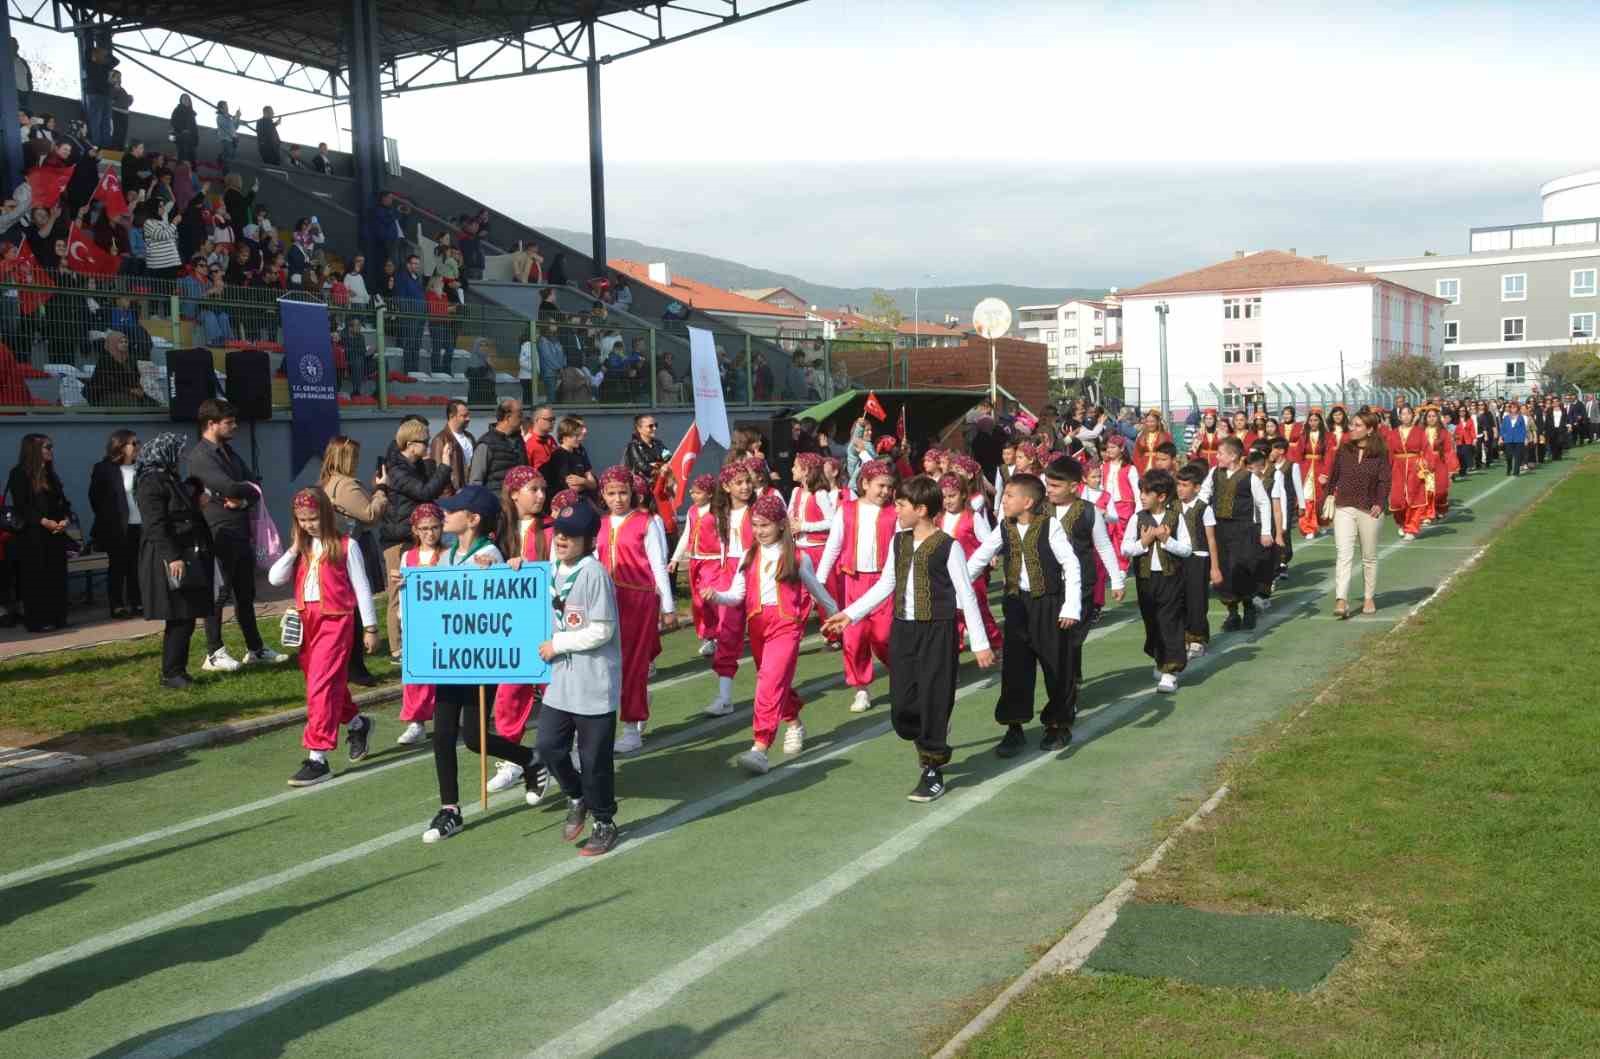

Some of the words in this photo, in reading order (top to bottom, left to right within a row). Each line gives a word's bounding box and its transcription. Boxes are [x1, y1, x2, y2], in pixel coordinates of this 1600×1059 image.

[416, 573, 477, 602] İSMAİL
[483, 576, 537, 601] HAKKI
[441, 612, 513, 638] TONGUÇ
[432, 641, 521, 670] İLKOKULU
